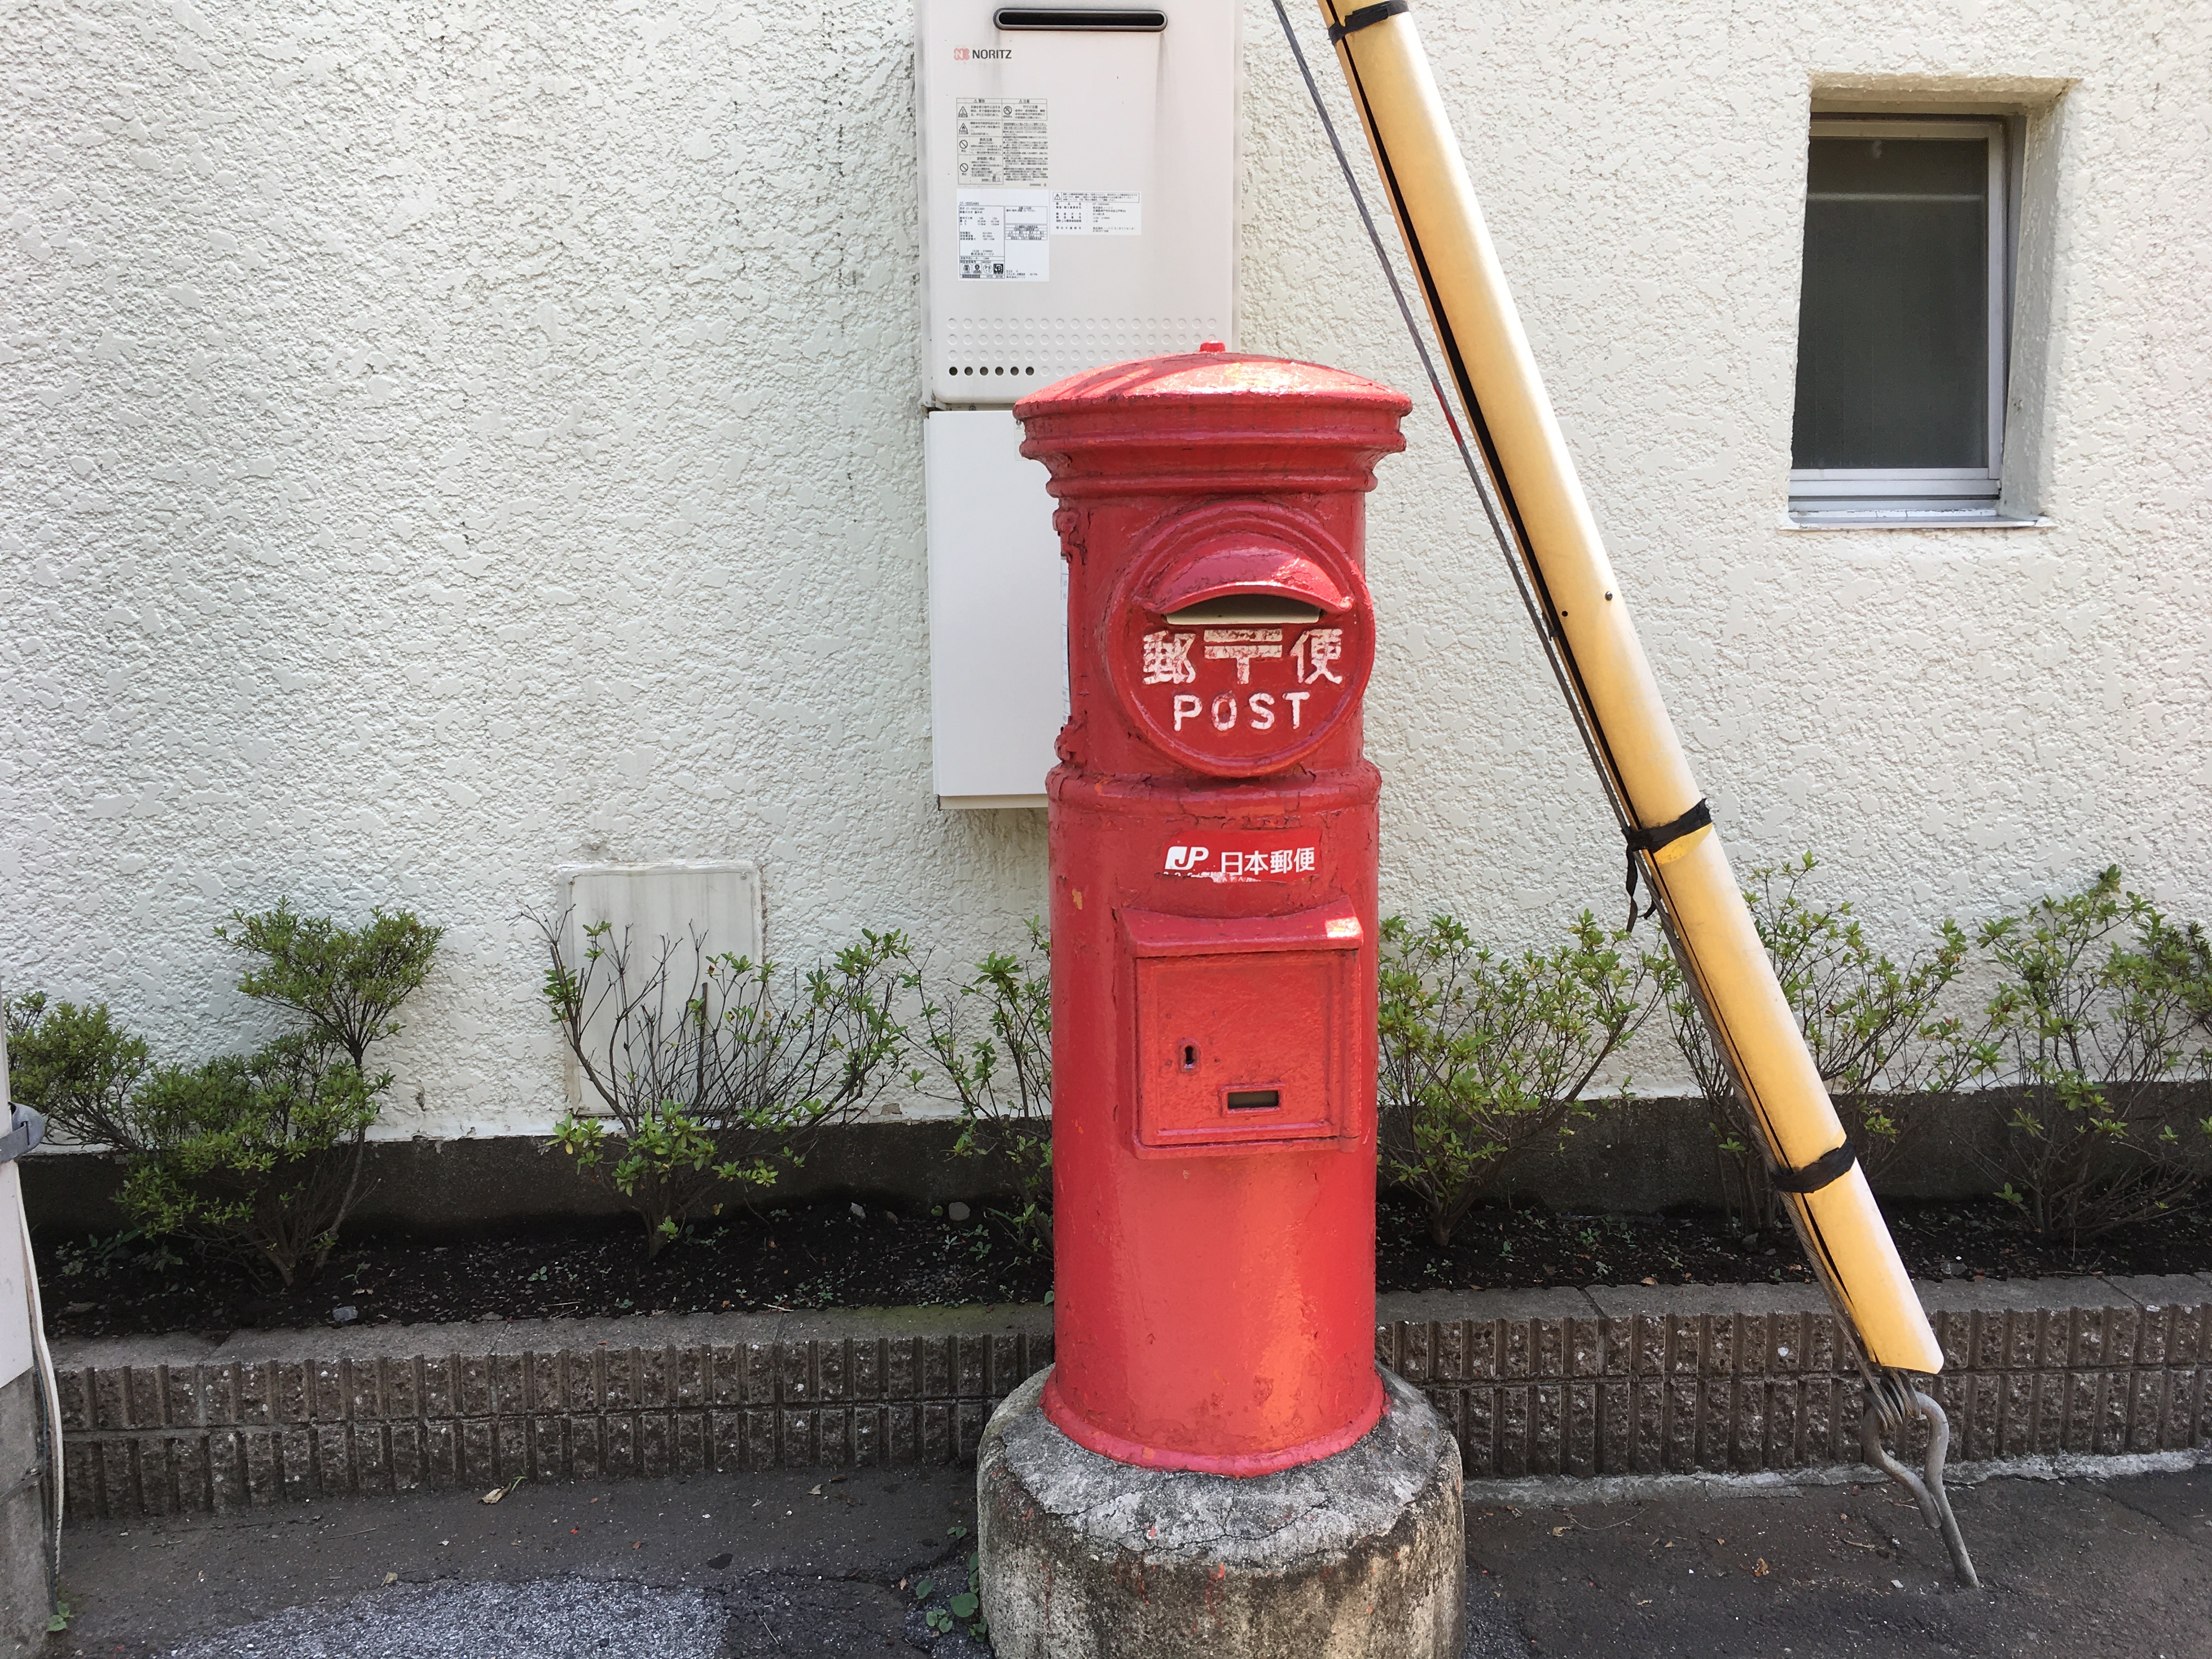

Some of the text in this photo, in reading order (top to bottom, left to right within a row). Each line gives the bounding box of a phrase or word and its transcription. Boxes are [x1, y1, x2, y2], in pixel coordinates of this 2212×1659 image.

[972, 49, 1012, 59] NORITZ
[1173, 691, 1311, 732] POST
[1221, 847, 1315, 876] 日本郵便
